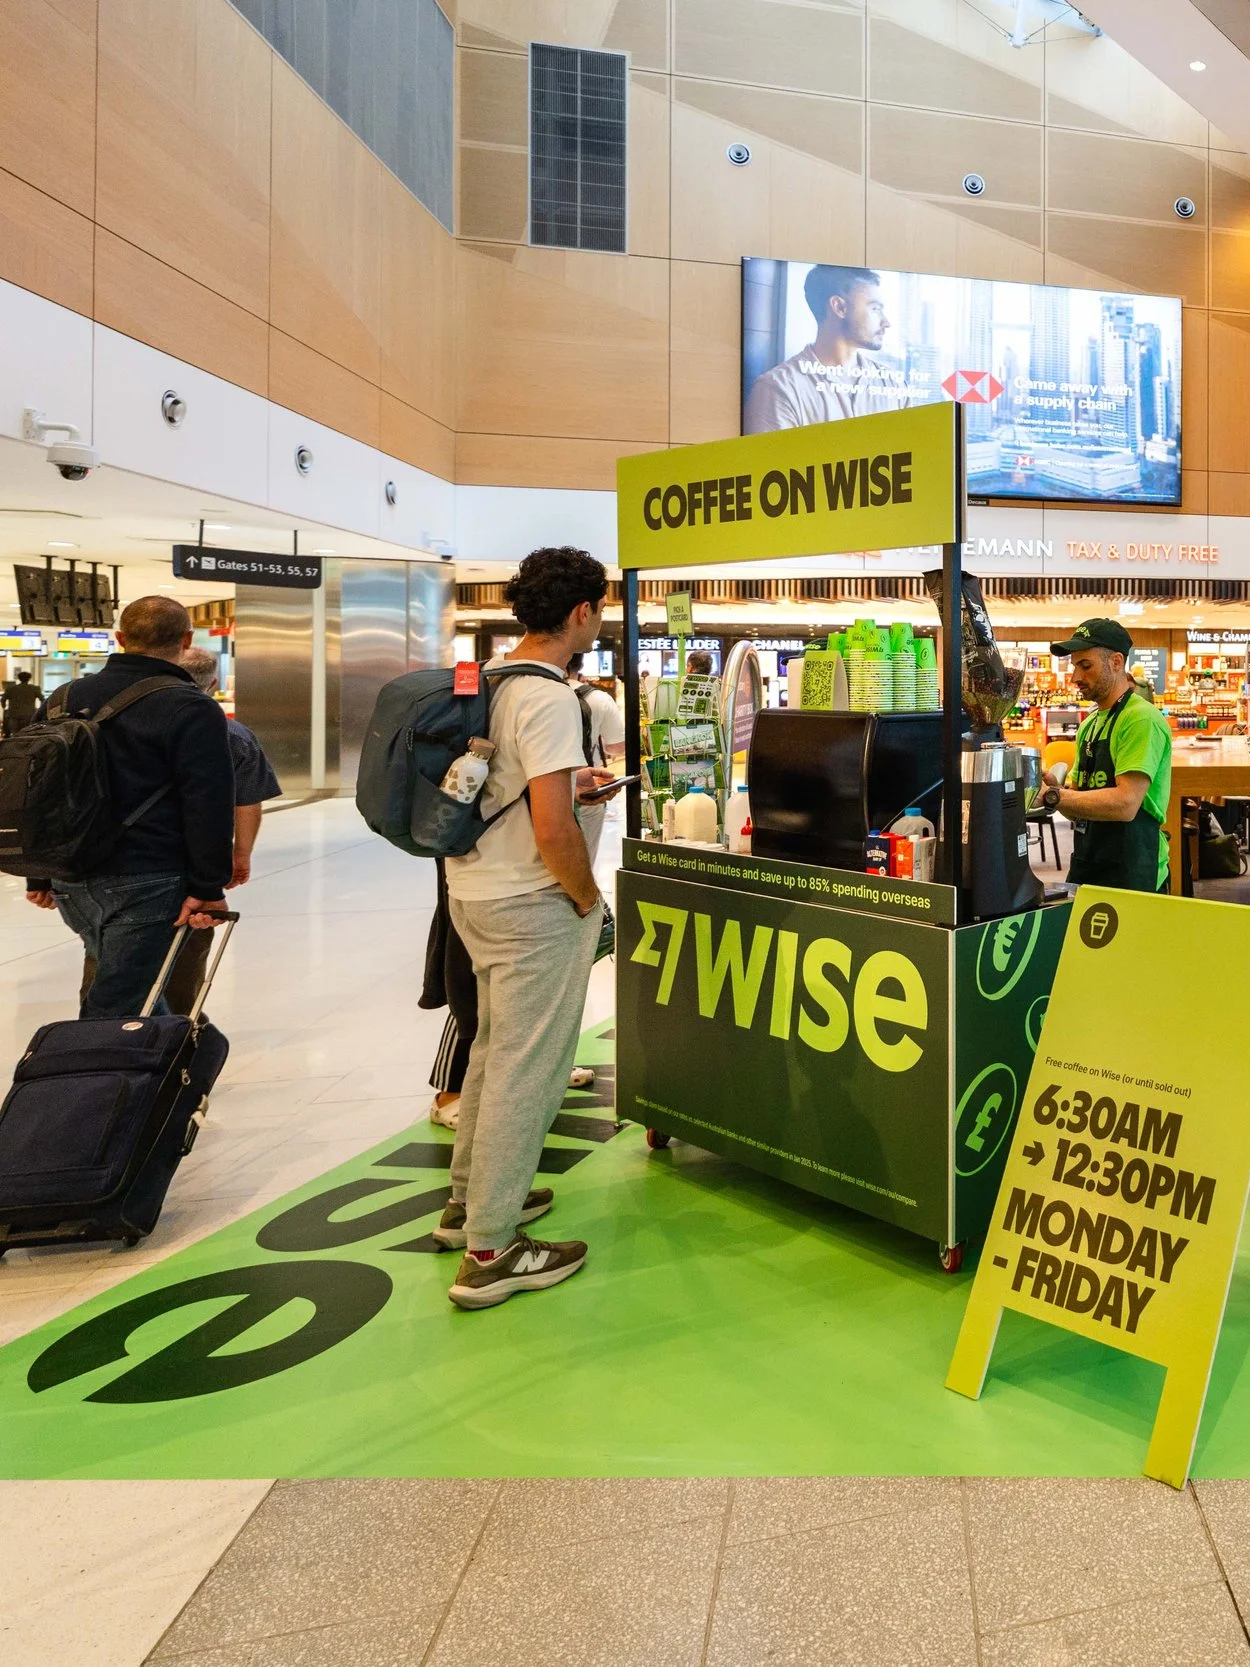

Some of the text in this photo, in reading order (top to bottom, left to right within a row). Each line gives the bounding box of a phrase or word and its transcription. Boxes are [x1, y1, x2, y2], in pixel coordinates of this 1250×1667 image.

[799, 360, 931, 383] Went looking for
[816, 381, 824, 392] a
[1014, 376, 1133, 397] Came away with
[1014, 395, 1117, 411] a supply chain
[644, 452, 912, 531] COFFEE ON WISE
[1067, 541, 1101, 559] TAX
[1107, 543, 1120, 559] &
[1126, 543, 1172, 560] DUTY
[1178, 545, 1219, 562] FREE
[217, 560, 248, 571] Gates
[287, 566, 303, 576] 55,
[305, 568, 318, 576] 57
[637, 638, 671, 650] ESTÉE
[750, 640, 805, 650] CHANEL
[637, 850, 931, 909] Get a Wise card in minutes and save up to 85% spending overseas
[1045, 1056, 1192, 1098] Free coffee on Wise (or until sold out)
[1033, 1083, 1183, 1158] 6:30AM
[1052, 1137, 1216, 1225] 12:30PM
[1002, 1187, 1190, 1284] MONDAY
[1011, 1245, 1156, 1334] FRIDAY
